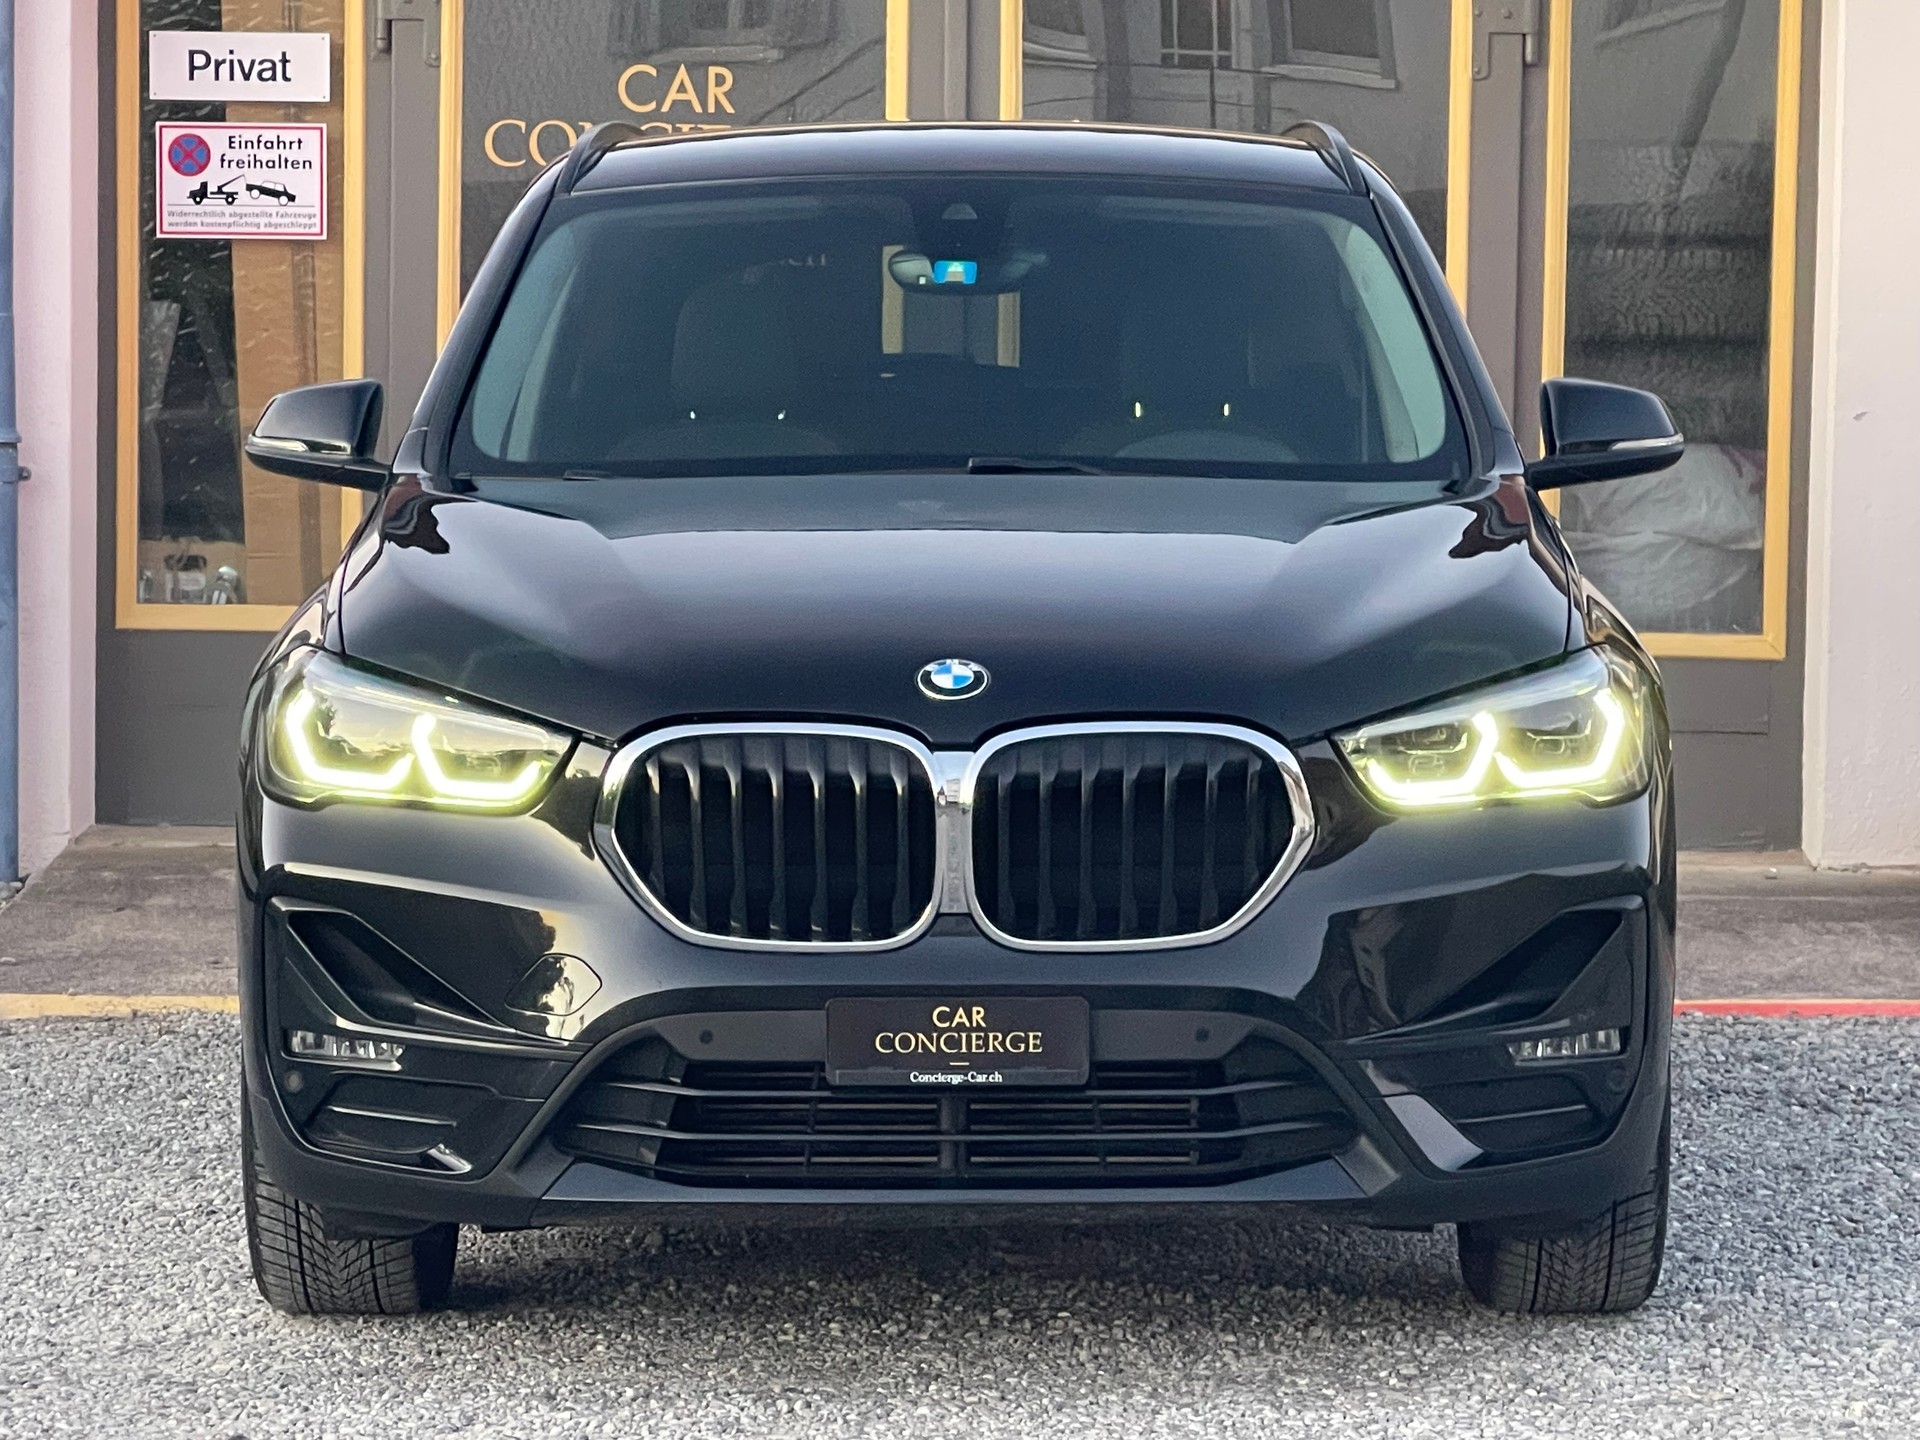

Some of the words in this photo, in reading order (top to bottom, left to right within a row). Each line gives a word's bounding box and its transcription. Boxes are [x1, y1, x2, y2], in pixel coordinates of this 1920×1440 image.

[187, 49, 291, 82] Privat
[617, 63, 735, 114] CAR
[228, 135, 303, 150] Einfahrt
[220, 154, 313, 169] freihalten
[167, 210, 226, 218] Widerrechtlich
[228, 211, 273, 220] abgestellte
[275, 211, 317, 220] Fahrzeuge
[263, 221, 317, 229] abgeschleppt
[932, 1006, 987, 1028] CAR
[875, 1032, 1043, 1053] CONCIERGE
[910, 1071, 1003, 1084] Concierge-Car.ch
